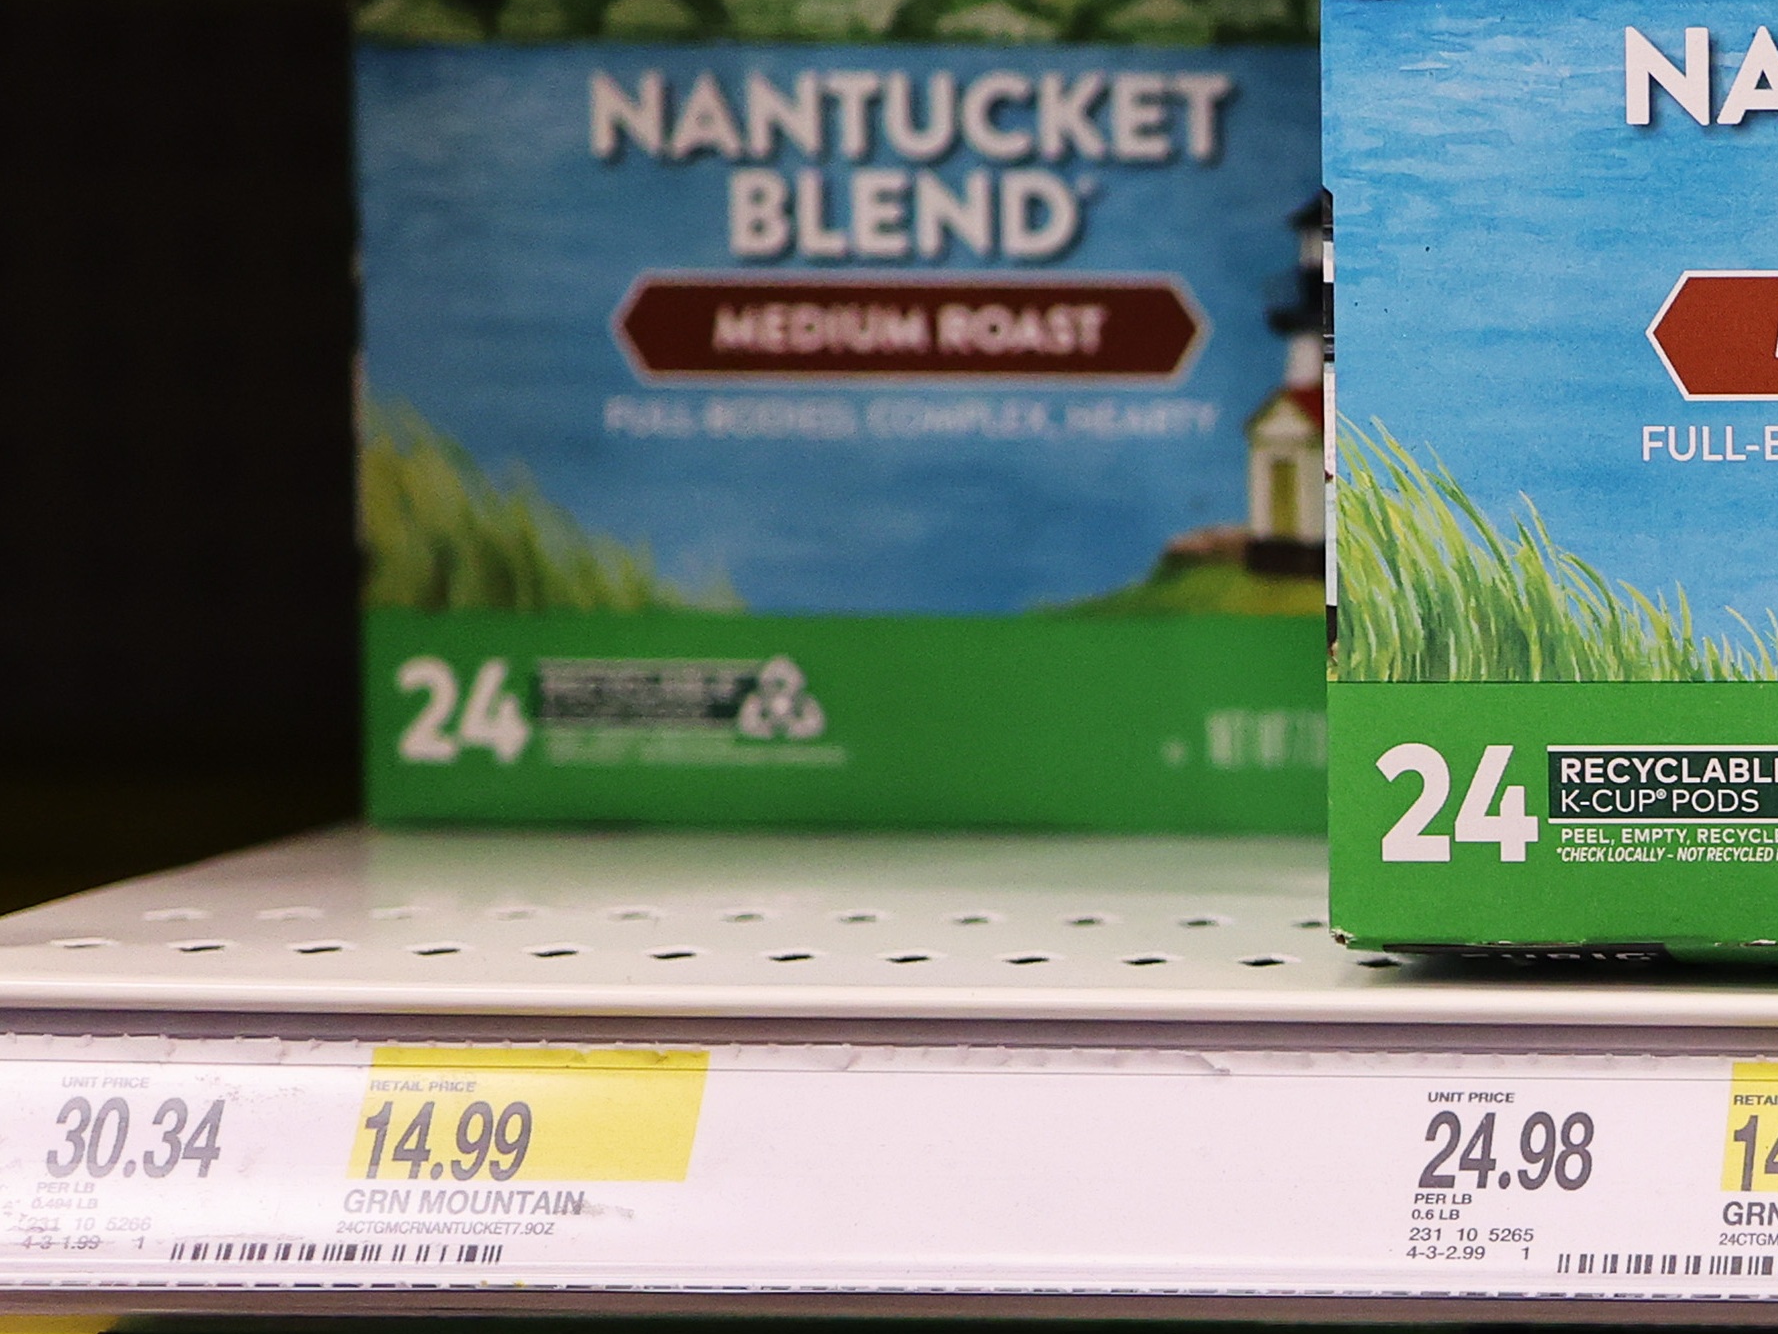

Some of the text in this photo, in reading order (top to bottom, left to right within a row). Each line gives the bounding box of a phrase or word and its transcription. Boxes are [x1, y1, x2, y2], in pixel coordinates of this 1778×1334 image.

[588, 71, 1233, 161] NANTUCKET
[397, 657, 532, 764] 24
[1376, 743, 1538, 862] 24
[1562, 828, 1615, 845] PEEL,
[1622, 828, 1690, 845] EMPTY,
[1427, 1092, 1515, 1103] UNIT PRICE
[46, 1096, 224, 1179] 30.34
[364, 1101, 533, 1181] 14.99
[1418, 1111, 1595, 1191] 24.98
[343, 1190, 585, 1216] GRN MOUNTAIN
[1414, 1193, 1472, 1205] PER LB
[1411, 1209, 1460, 1220] 0.6 LB
[1409, 1227, 1534, 1242] 231 10 5265
[1406, 1246, 1531, 1261] 4-3-2.99 1
